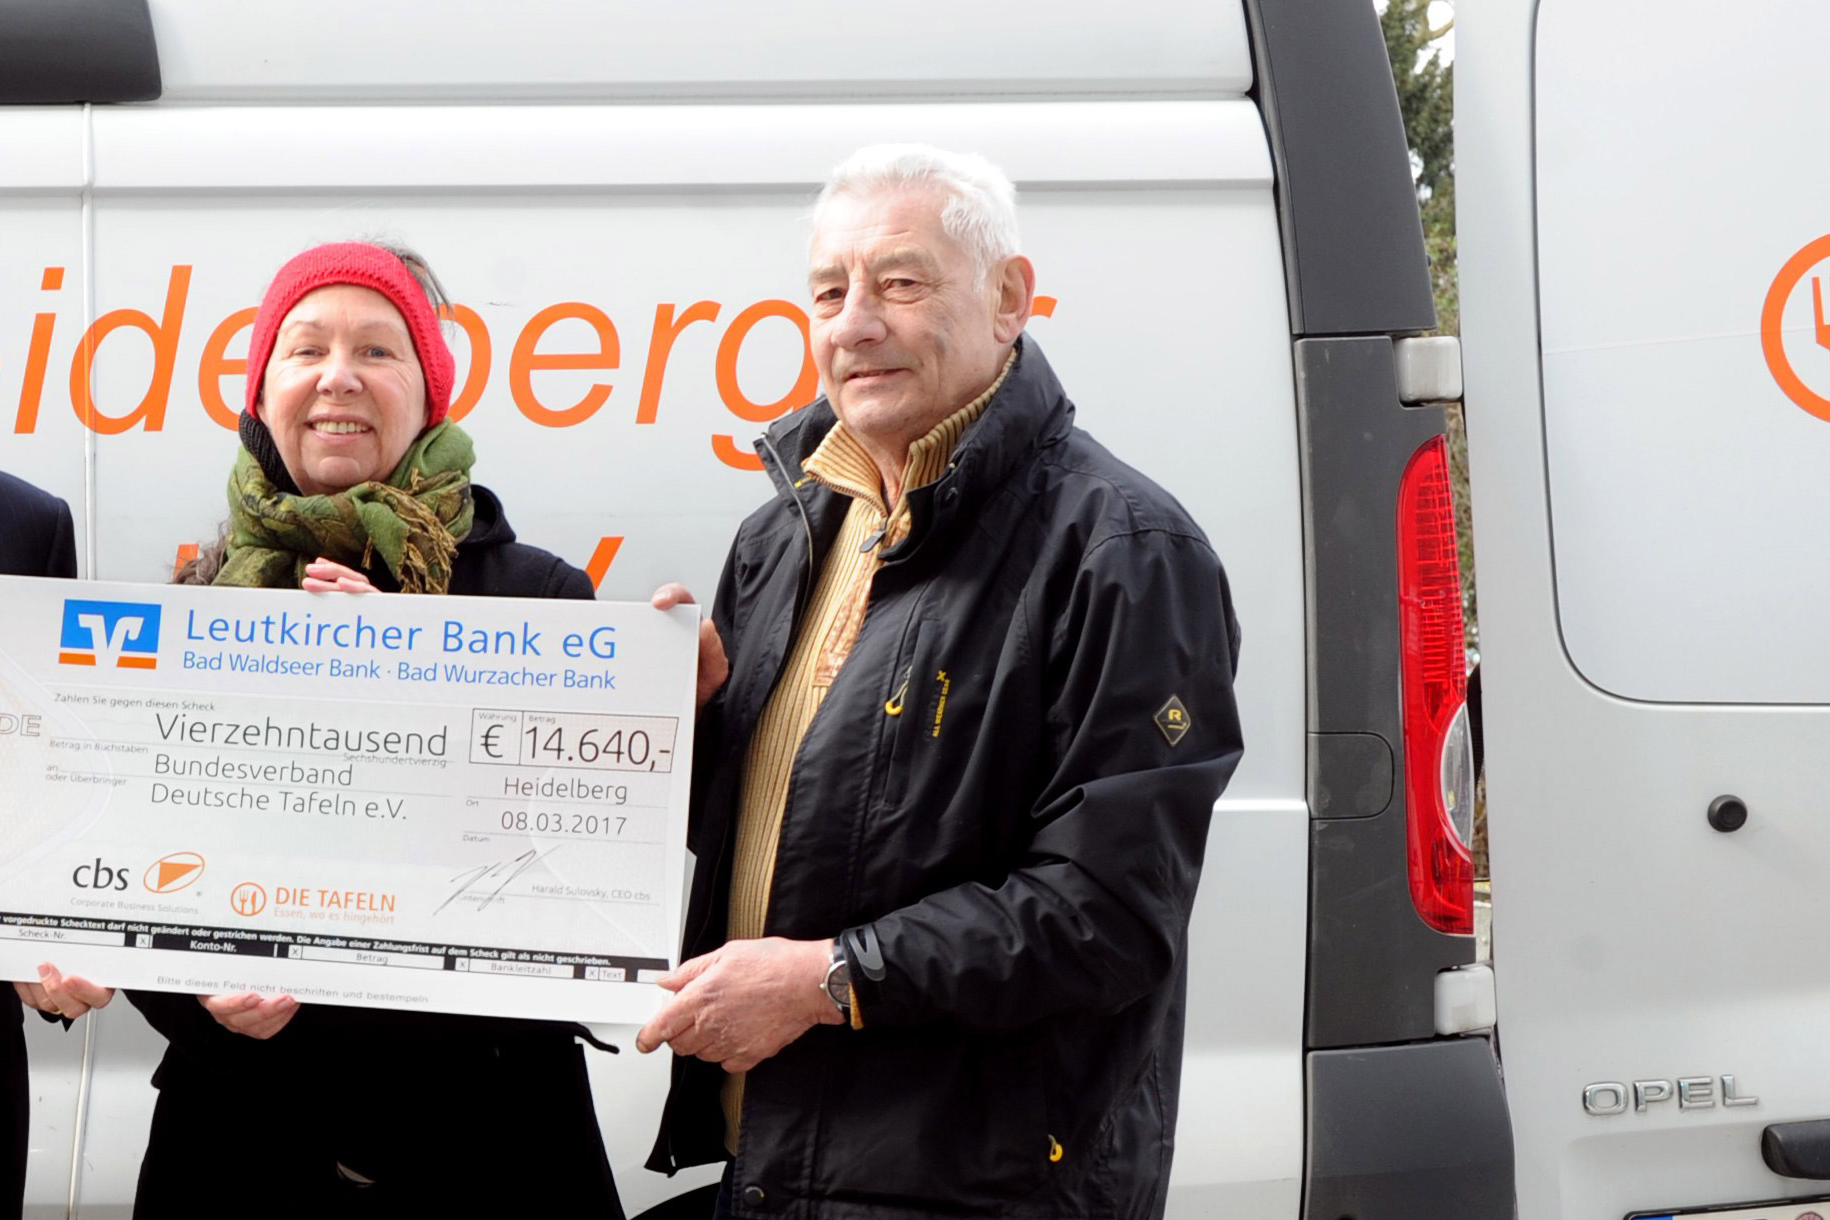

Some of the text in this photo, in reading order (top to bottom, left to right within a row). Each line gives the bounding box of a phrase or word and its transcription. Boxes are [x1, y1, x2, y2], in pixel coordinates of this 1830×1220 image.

[186, 608, 616, 659] Leutkircher Bank eG
[182, 650, 223, 671] Bad
[229, 652, 324, 677] Waldseer
[328, 658, 381, 680] Bank
[397, 661, 438, 683] Bad
[443, 663, 558, 687] Wurzacher
[562, 668, 617, 690] Bank
[54, 692, 215, 711] Zahlen Sie gegen diesen Scheck
[50, 739, 80, 751] Betrag
[94, 741, 149, 754] Buchstaben
[155, 713, 448, 757] Vierzehntausend
[480, 723, 671, 772] € 14.640,-
[154, 753, 353, 786] Bundesverband
[150, 782, 407, 820] Deutsche Tafeln e.V.
[503, 776, 628, 806] Heidelberg
[500, 809, 628, 837] 08.03.2017
[72, 857, 130, 891] cbs
[275, 886, 396, 913] DIE TAFELN
[611, 889, 632, 900] CEO
[3, 914, 58, 927] vorgedruckte
[60, 918, 105, 930] Schecktext
[107, 921, 126, 931] darf
[127, 922, 149, 932] nicht
[151, 924, 189, 937] geändert
[191, 927, 211, 938] oder
[213, 929, 258, 941] gestrichen
[296, 935, 311, 945] Die
[313, 936, 347, 948] Angabe
[349, 939, 372, 949] einer
[373, 940, 429, 954] Zahlungsfrist
[431, 945, 446, 955] auf
[448, 946, 468, 956] dem
[470, 948, 499, 959] Scheck
[532, 952, 555, 962] nicht
[189, 940, 237, 953] Konto-Nr.
[356, 952, 389, 965] Betrag
[490, 962, 552, 975] Bankleitzahl
[157, 975, 181, 986] Bitte
[184, 978, 219, 989] dieses
[223, 980, 247, 991] Feld
[250, 983, 276, 993] nicht
[342, 990, 363, 999] und
[601, 969, 622, 980] Text
[1581, 1074, 1760, 1116] OPEL
